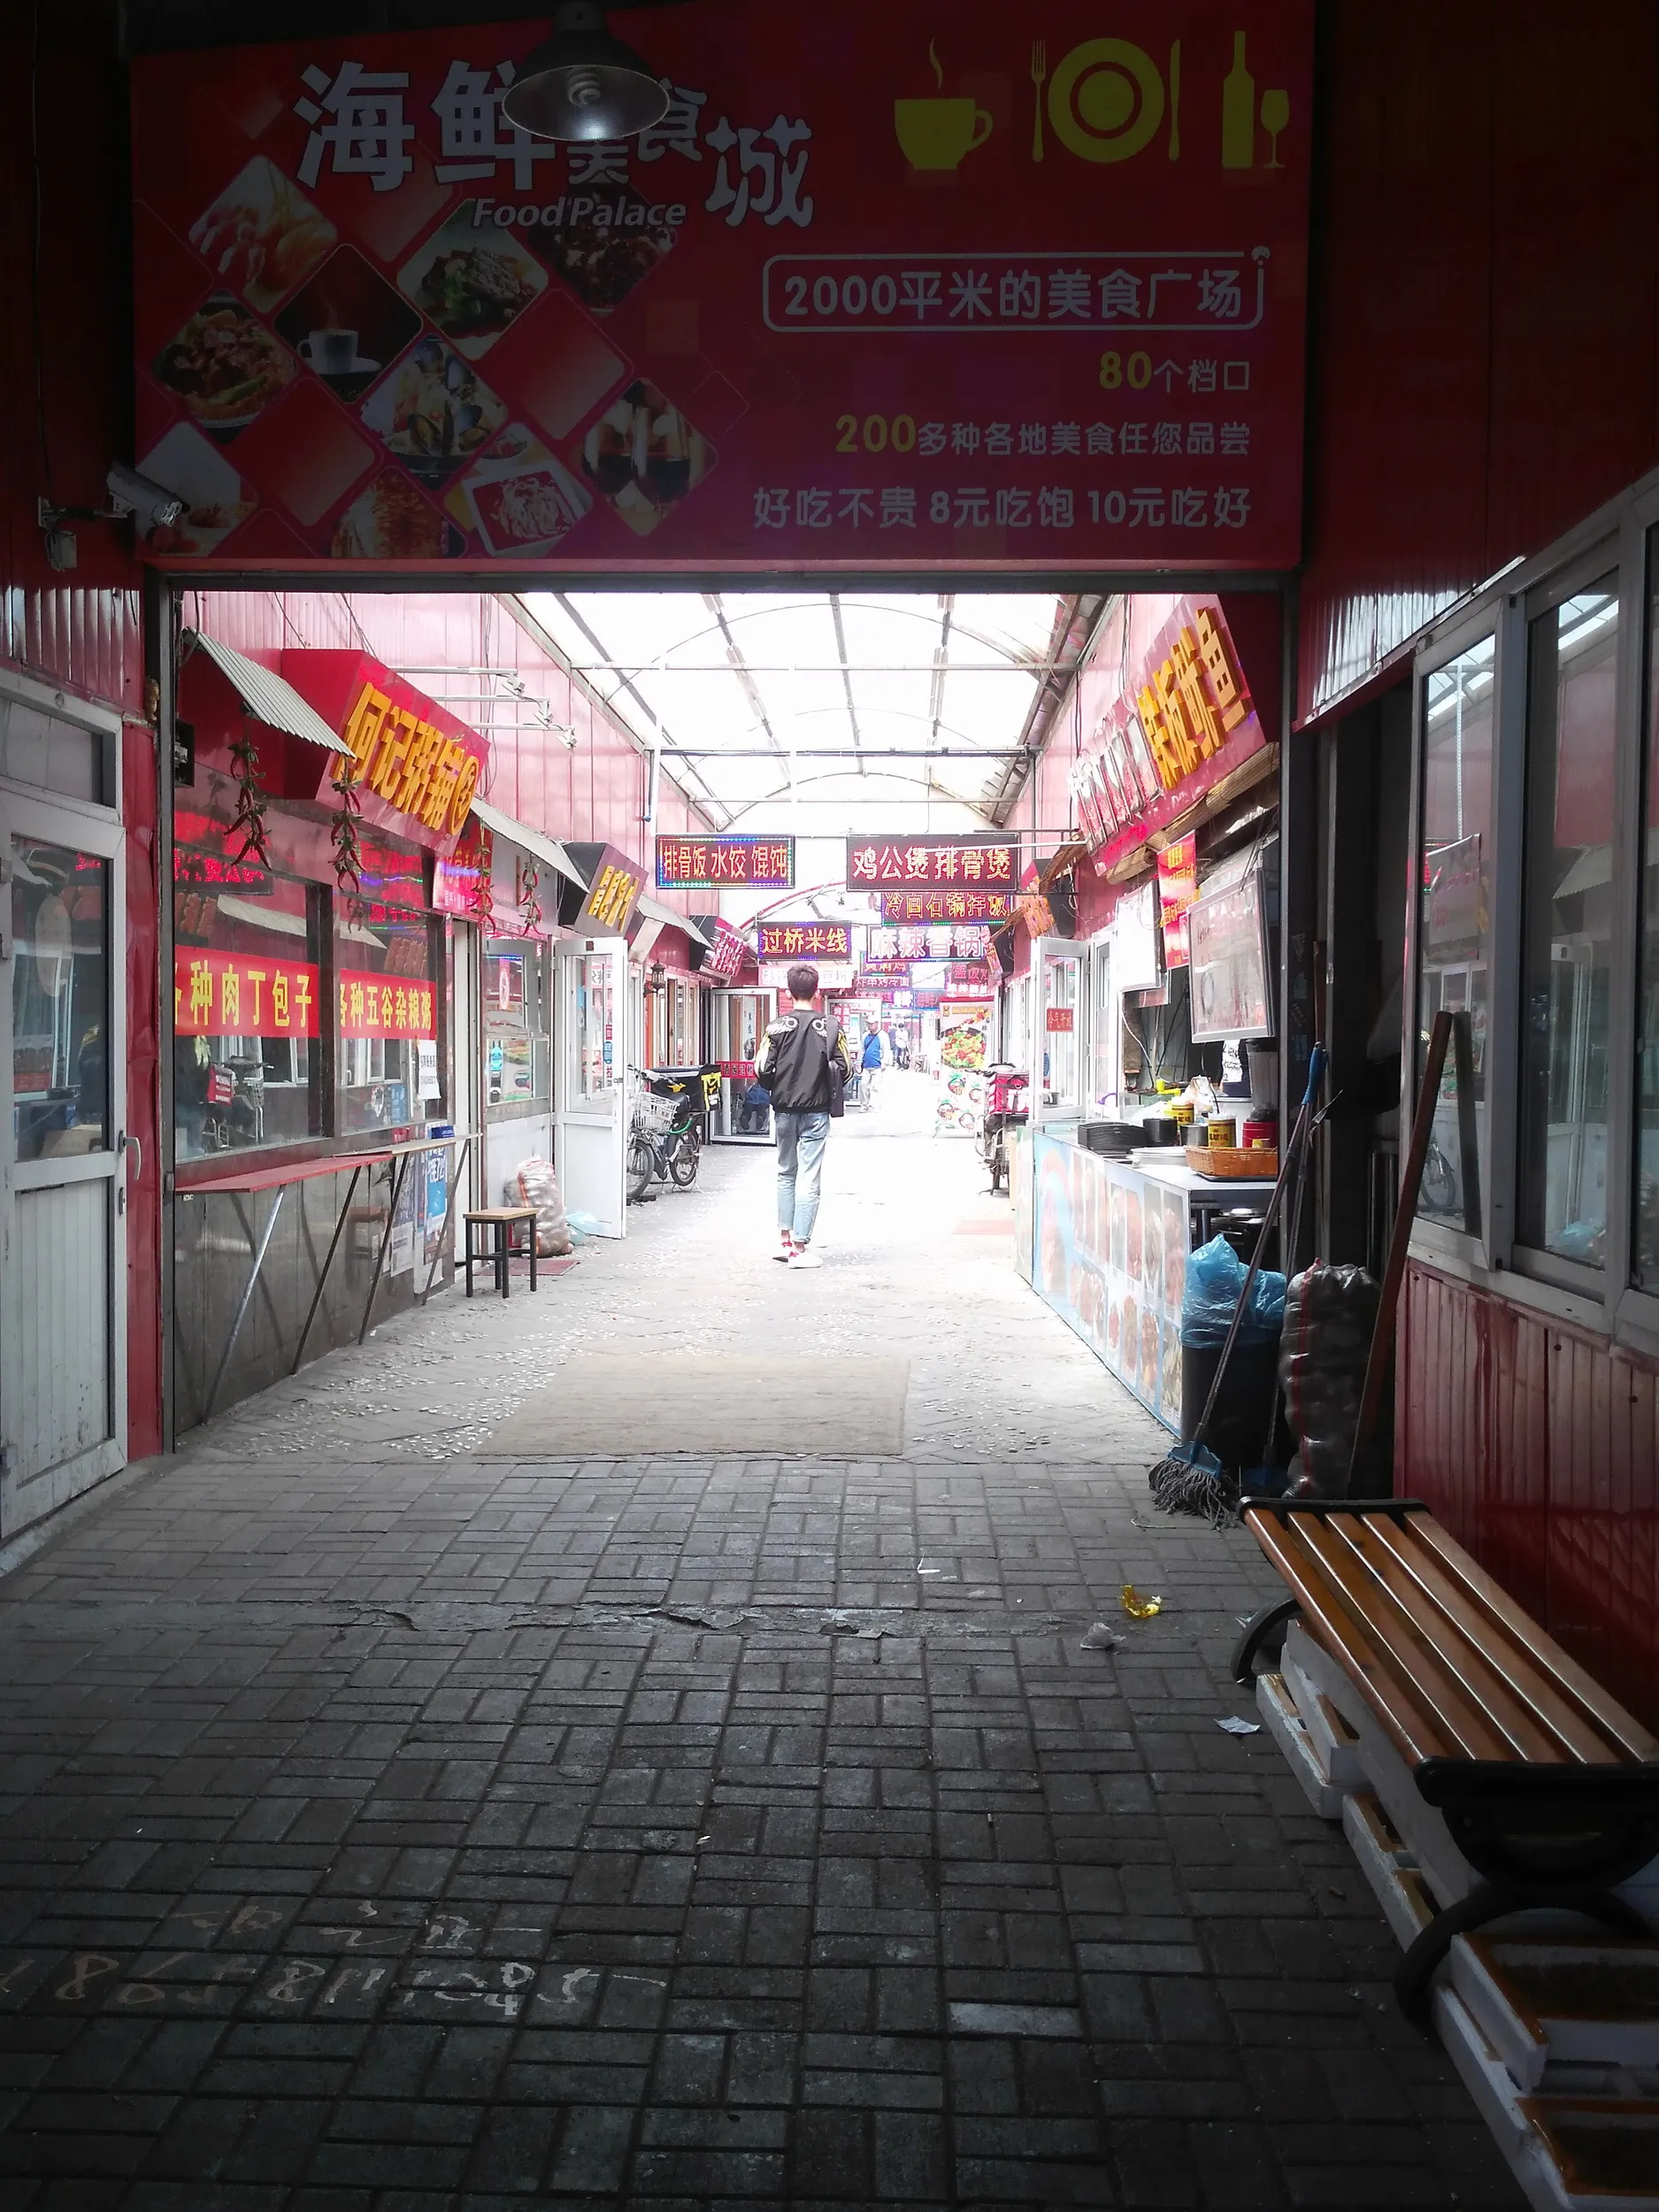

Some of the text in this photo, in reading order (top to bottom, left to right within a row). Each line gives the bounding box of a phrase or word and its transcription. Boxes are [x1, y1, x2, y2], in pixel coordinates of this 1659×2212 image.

[784, 268, 1241, 320] 2000平米的美食广场
[1098, 350, 1251, 393] 80个档口
[834, 413, 1251, 457] 200多种各地美食任您品尝
[753, 486, 1251, 529] 好吃不贵 8元吃饱 10元吃好
[333, 682, 467, 831] 何记粥铺
[664, 844, 787, 879] 排骨饭 水饺 馄饨
[852, 845, 1011, 880] 鸡公煲 排骨煲
[762, 928, 848, 955] 过桥米线
[870, 926, 980, 959] 麻辣香锅
